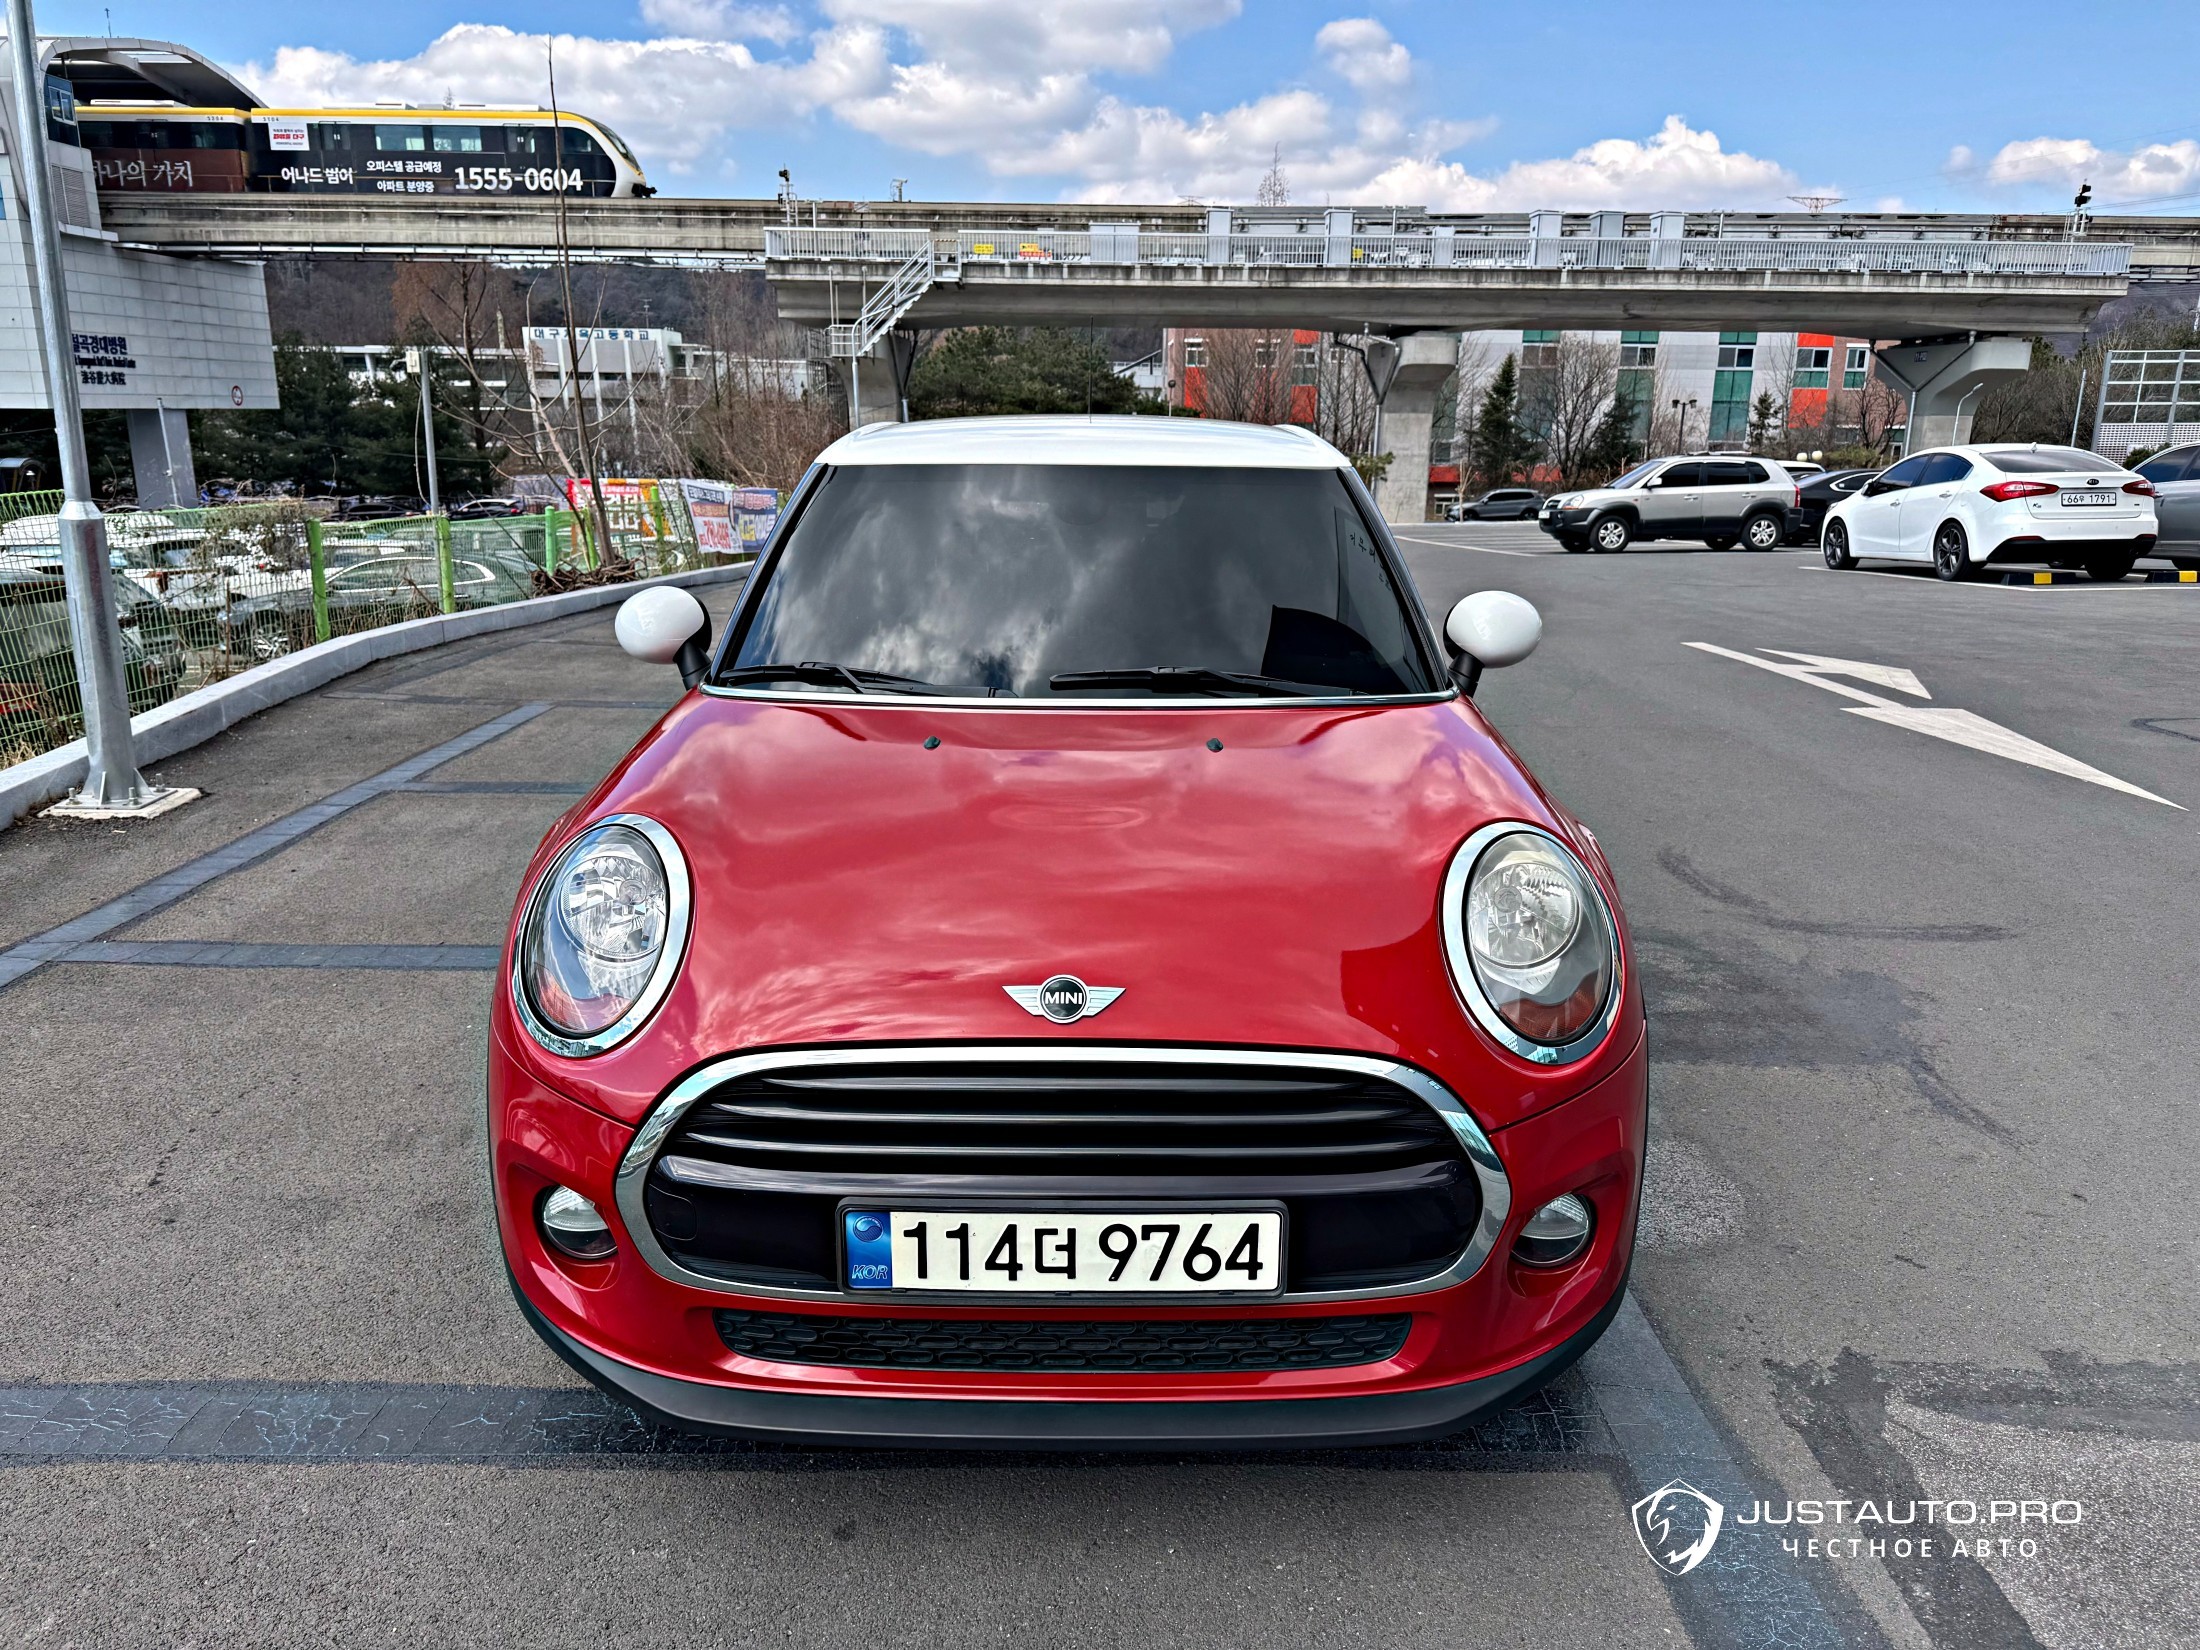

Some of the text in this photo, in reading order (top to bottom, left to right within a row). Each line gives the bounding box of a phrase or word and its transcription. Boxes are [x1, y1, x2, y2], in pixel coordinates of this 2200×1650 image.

[153, 160, 194, 187] 가치
[366, 160, 442, 173] 오피스텔 공급예정
[281, 166, 354, 185] 어나드 범어
[454, 166, 584, 192] 1555-0604
[377, 181, 435, 193] 아파트 분양중
[2089, 494, 2111, 504] 1791
[1044, 991, 1083, 1005] MINI
[902, 1221, 1264, 1282] 114더 9764
[852, 1264, 888, 1280] KOR
